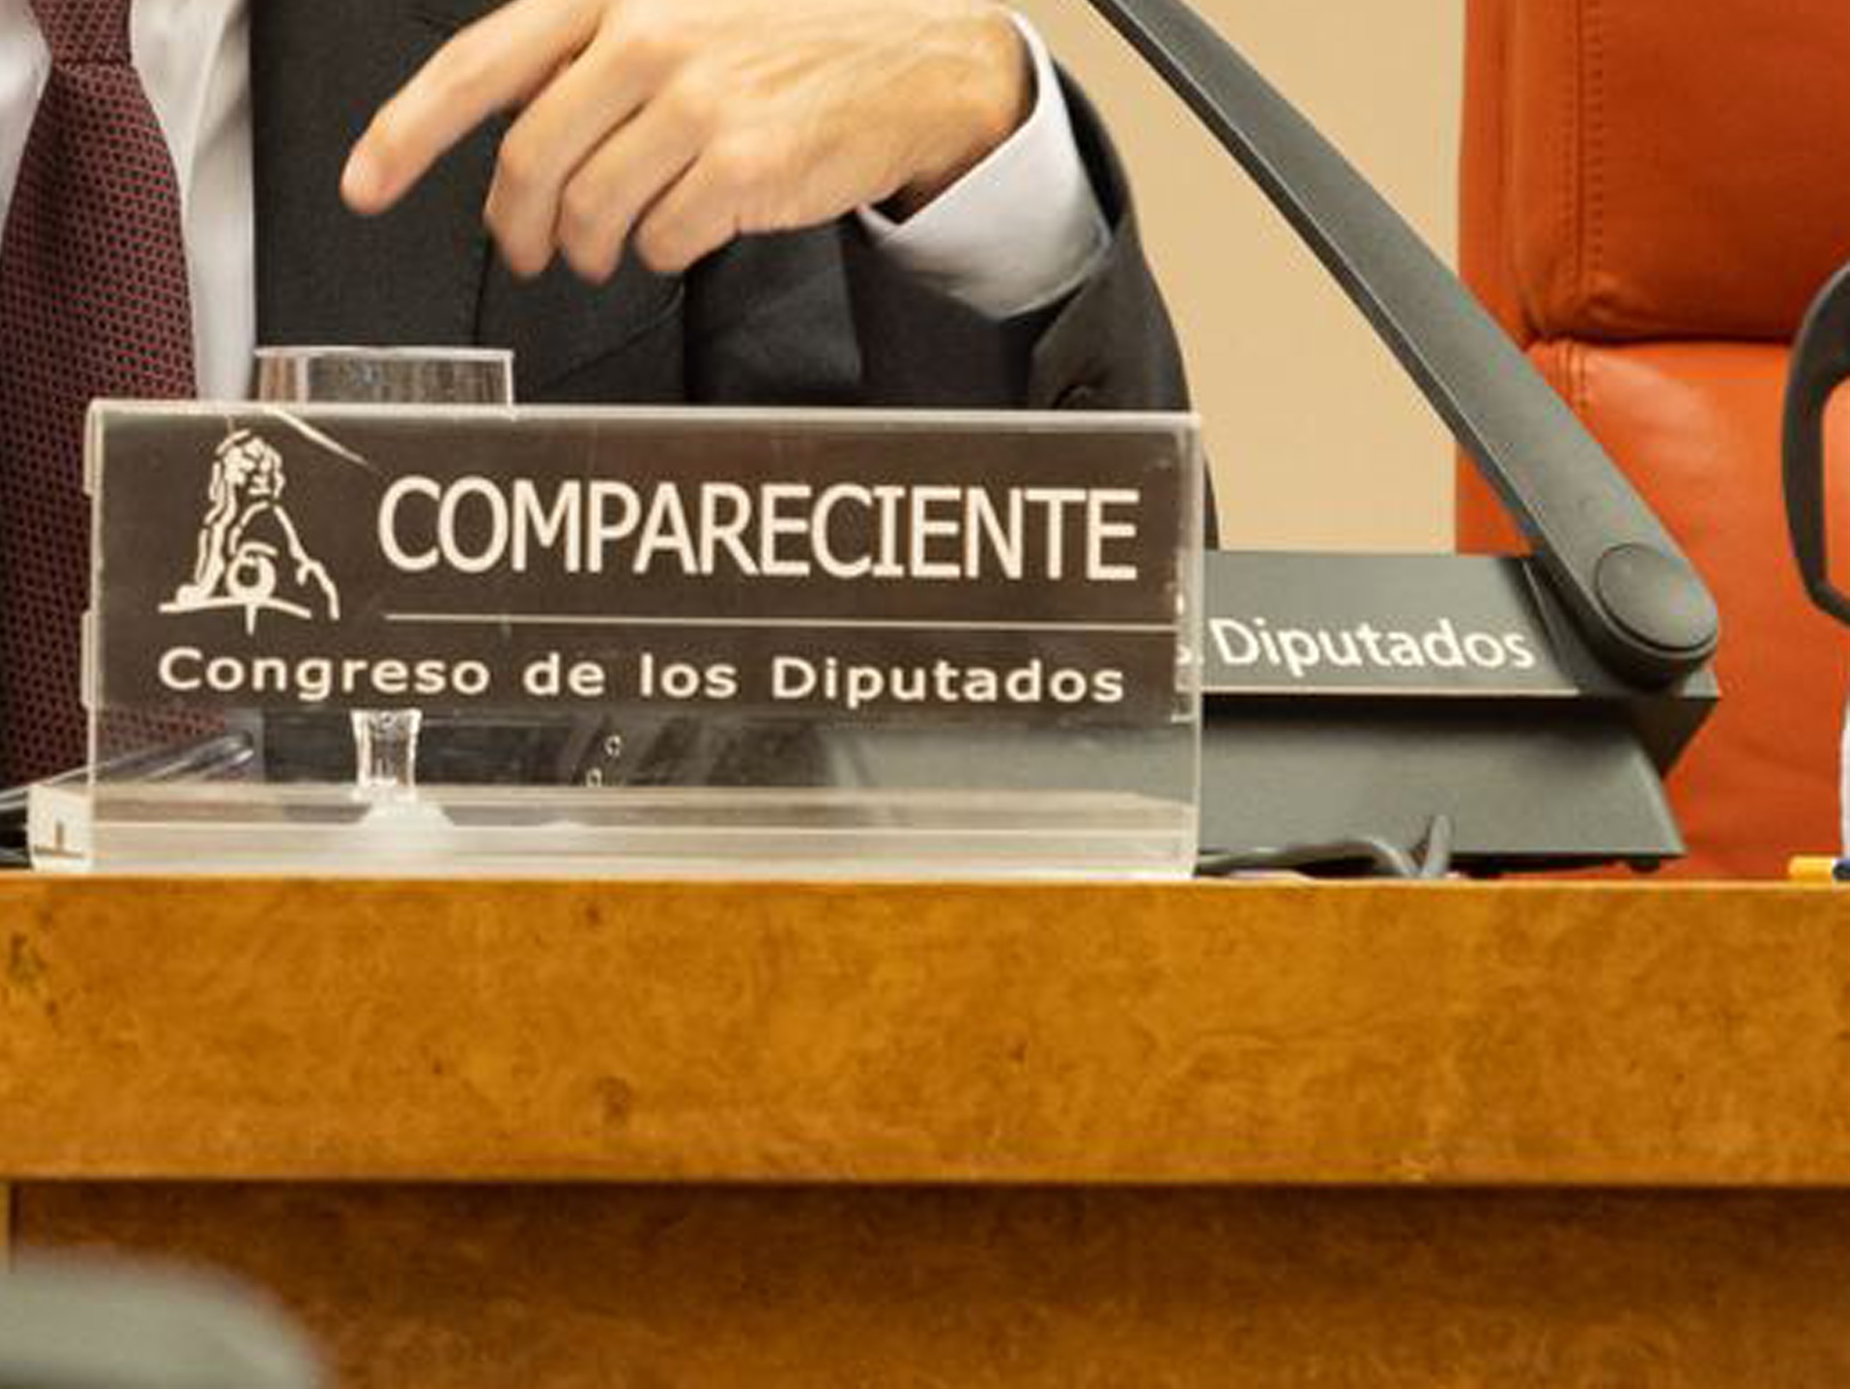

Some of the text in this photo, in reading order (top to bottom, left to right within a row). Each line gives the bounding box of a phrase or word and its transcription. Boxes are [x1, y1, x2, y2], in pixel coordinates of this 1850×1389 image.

[377, 475, 1140, 581] COMPARECIENTE
[156, 646, 1126, 709] Congreso de los Diputados
[1209, 618, 1536, 676] Diputados
